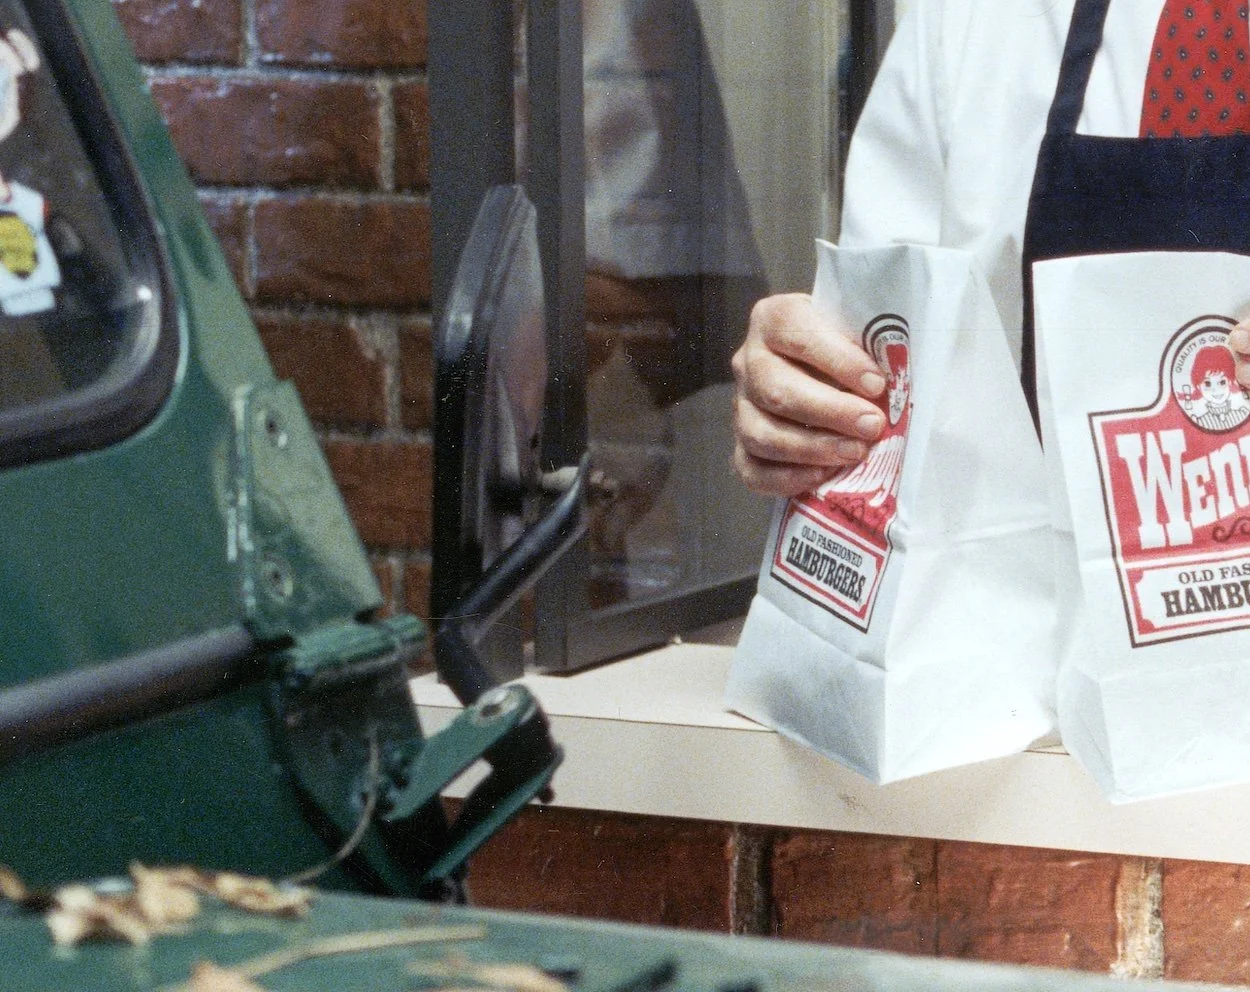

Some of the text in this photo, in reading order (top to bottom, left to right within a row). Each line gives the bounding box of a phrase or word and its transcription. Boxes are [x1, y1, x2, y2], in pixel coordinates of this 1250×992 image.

[1175, 335, 1227, 374] QUALITY IS OUR
[801, 525, 863, 568] OLD FASHIONED
[785, 536, 867, 603] HAMBURGERS
[1178, 569, 1215, 585] OLD
